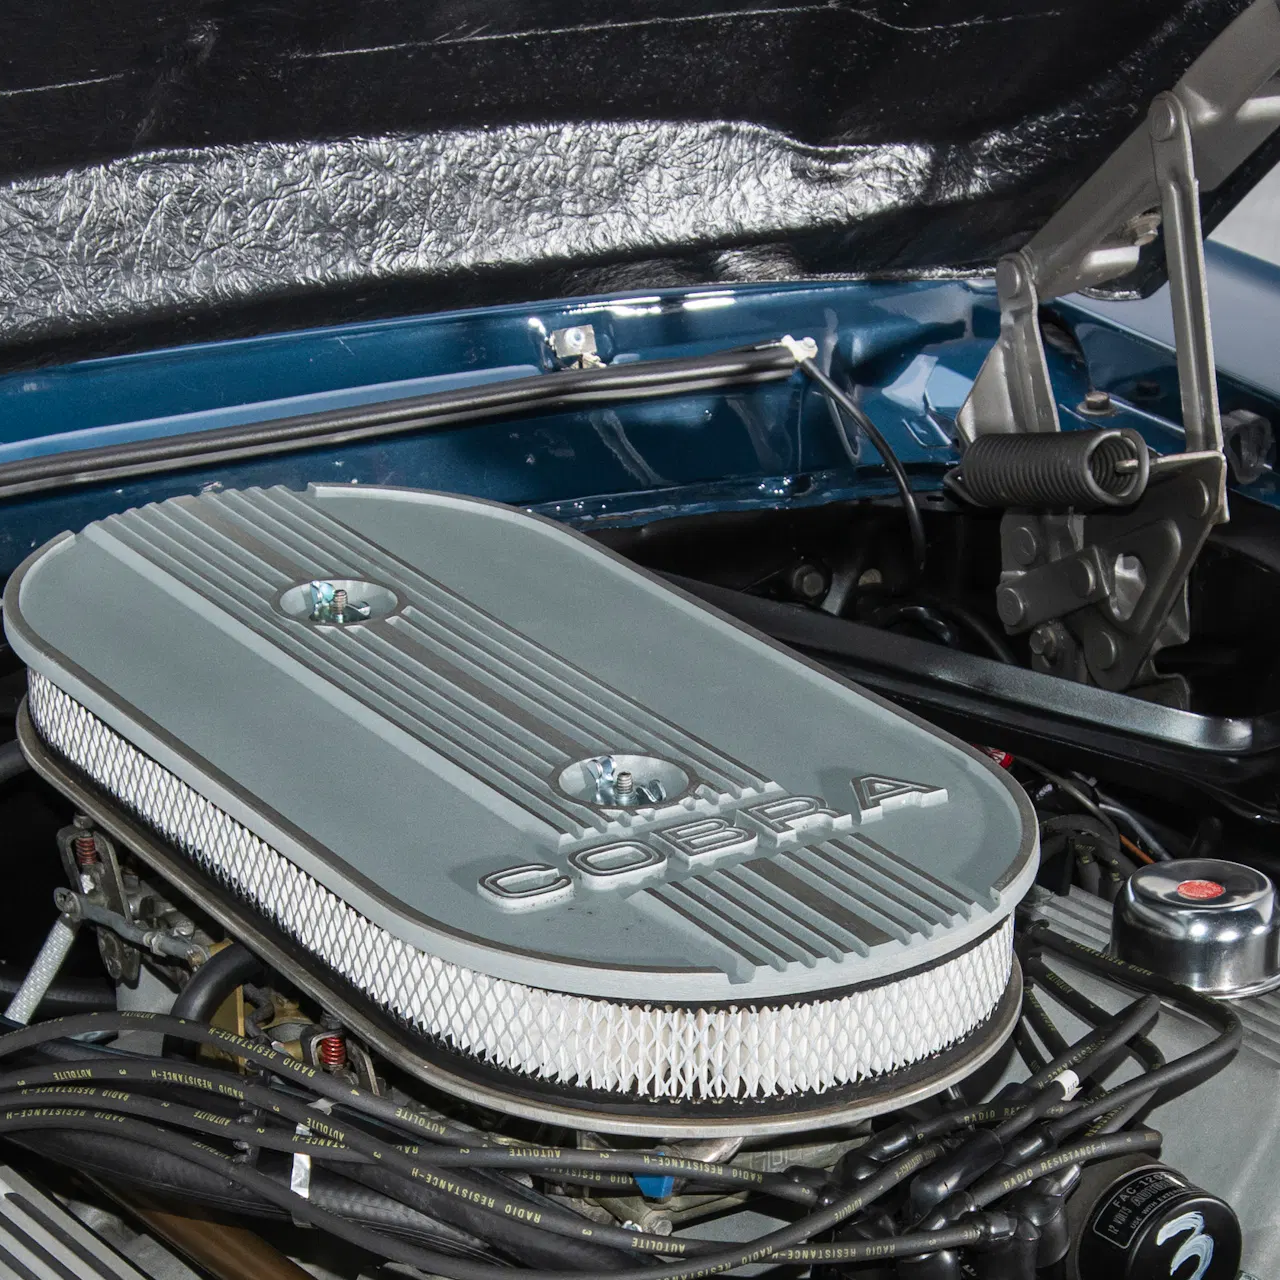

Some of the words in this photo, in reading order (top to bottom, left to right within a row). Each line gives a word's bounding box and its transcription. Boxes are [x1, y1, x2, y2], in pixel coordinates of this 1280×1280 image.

[477, 774, 948, 910] COBRA
[208, 1026, 277, 1061] RESISTANCE-H
[52, 1068, 92, 1081] AUTOLITE
[283, 1057, 317, 1078] RADIO
[306, 1117, 345, 1141] AUTOLITE
[395, 1108, 446, 1135] AUTOLITE
[509, 1148, 562, 1160] AUTOLITE
[643, 1155, 723, 1178] RESISTANCE-H
[732, 1168, 763, 1184] RADIO
[1003, 1168, 1034, 1190] RADIO
[1040, 1142, 1107, 1172] RESISTANCE-H
[411, 1167, 496, 1209] RESISTANCE-H
[504, 1204, 542, 1223] RADIO
[630, 1237, 686, 1255] AUTOLITE
[741, 1246, 773, 1265] RADIO
[865, 1244, 896, 1257] RADIO
